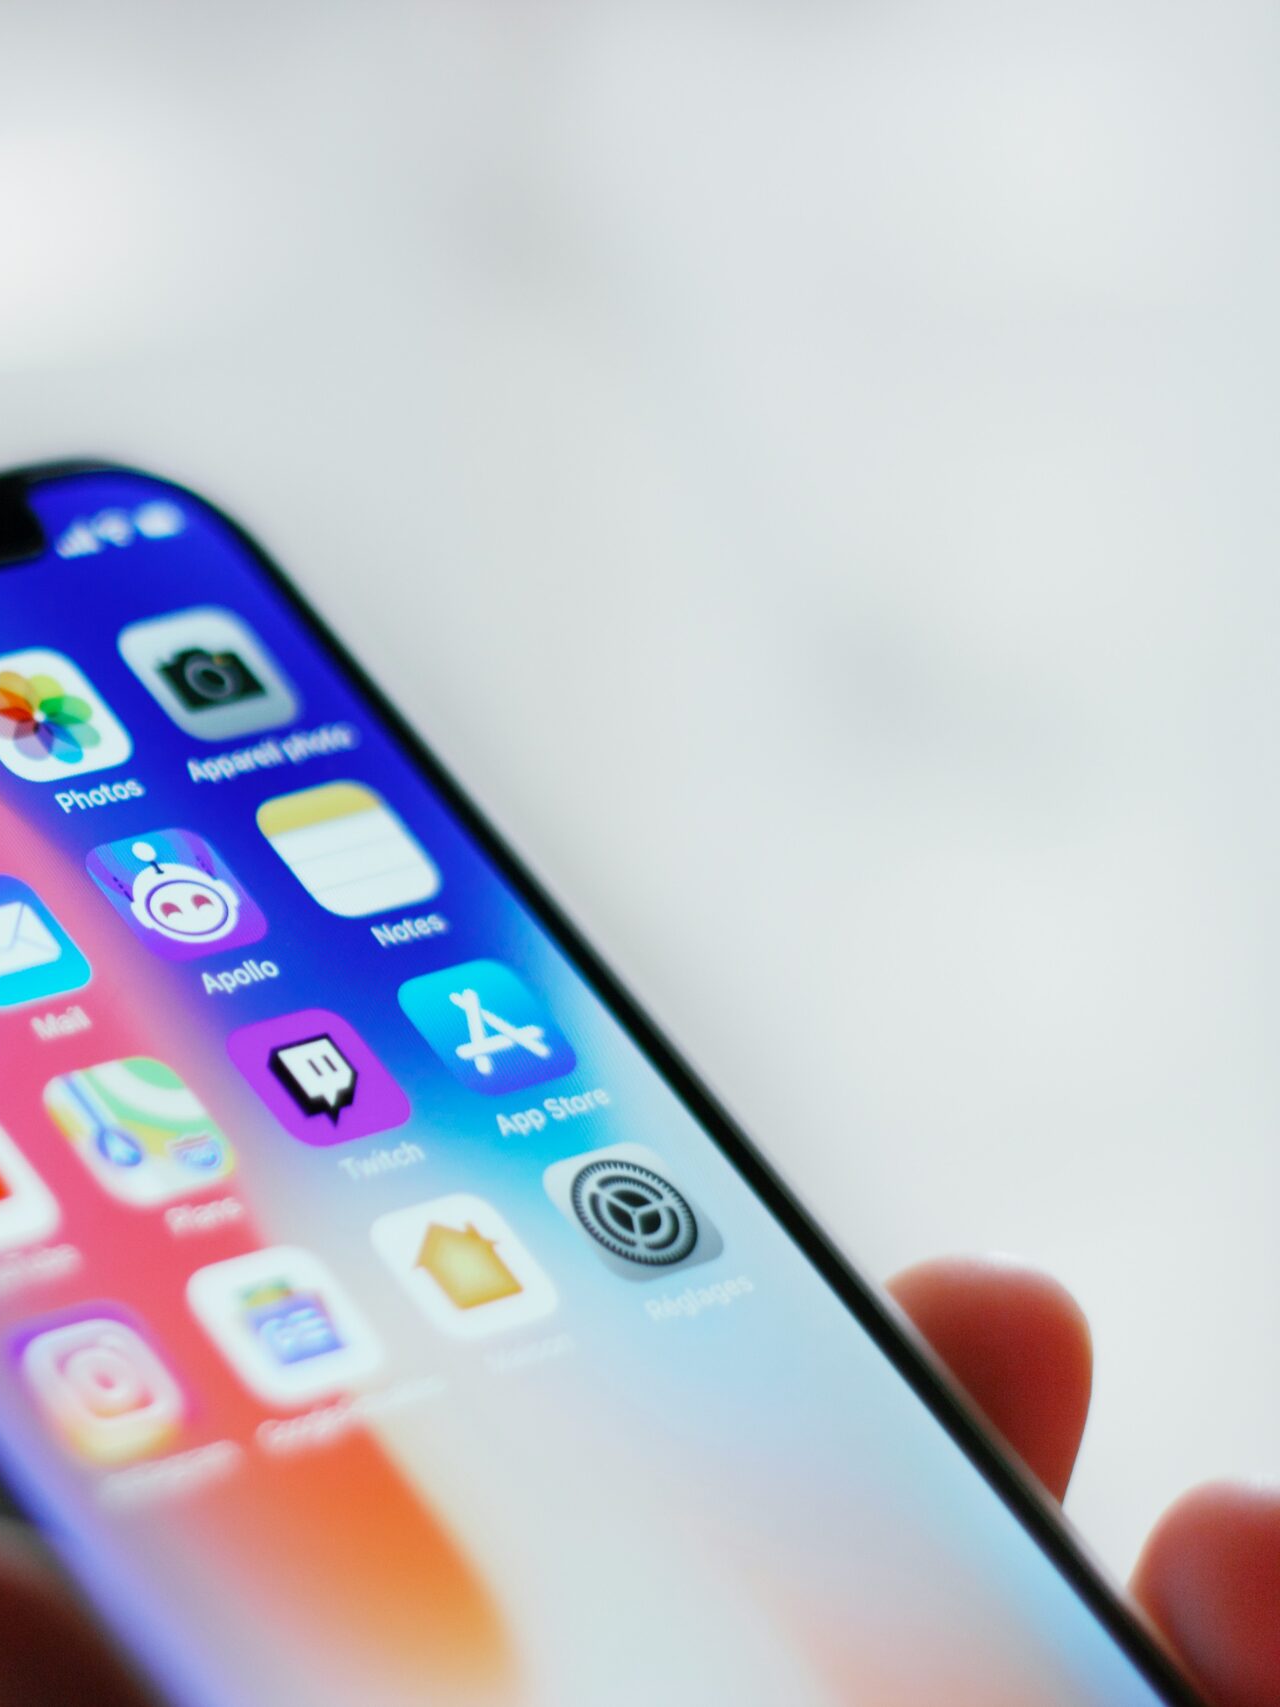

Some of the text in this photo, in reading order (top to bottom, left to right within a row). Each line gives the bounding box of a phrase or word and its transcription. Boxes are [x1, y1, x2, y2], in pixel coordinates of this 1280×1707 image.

[54, 778, 145, 814] Photos
[370, 911, 448, 948] Notes
[200, 955, 280, 995] Apollo
[30, 1005, 93, 1041] Mail
[494, 1085, 611, 1138] App Store
[338, 1141, 426, 1184] Twitch
